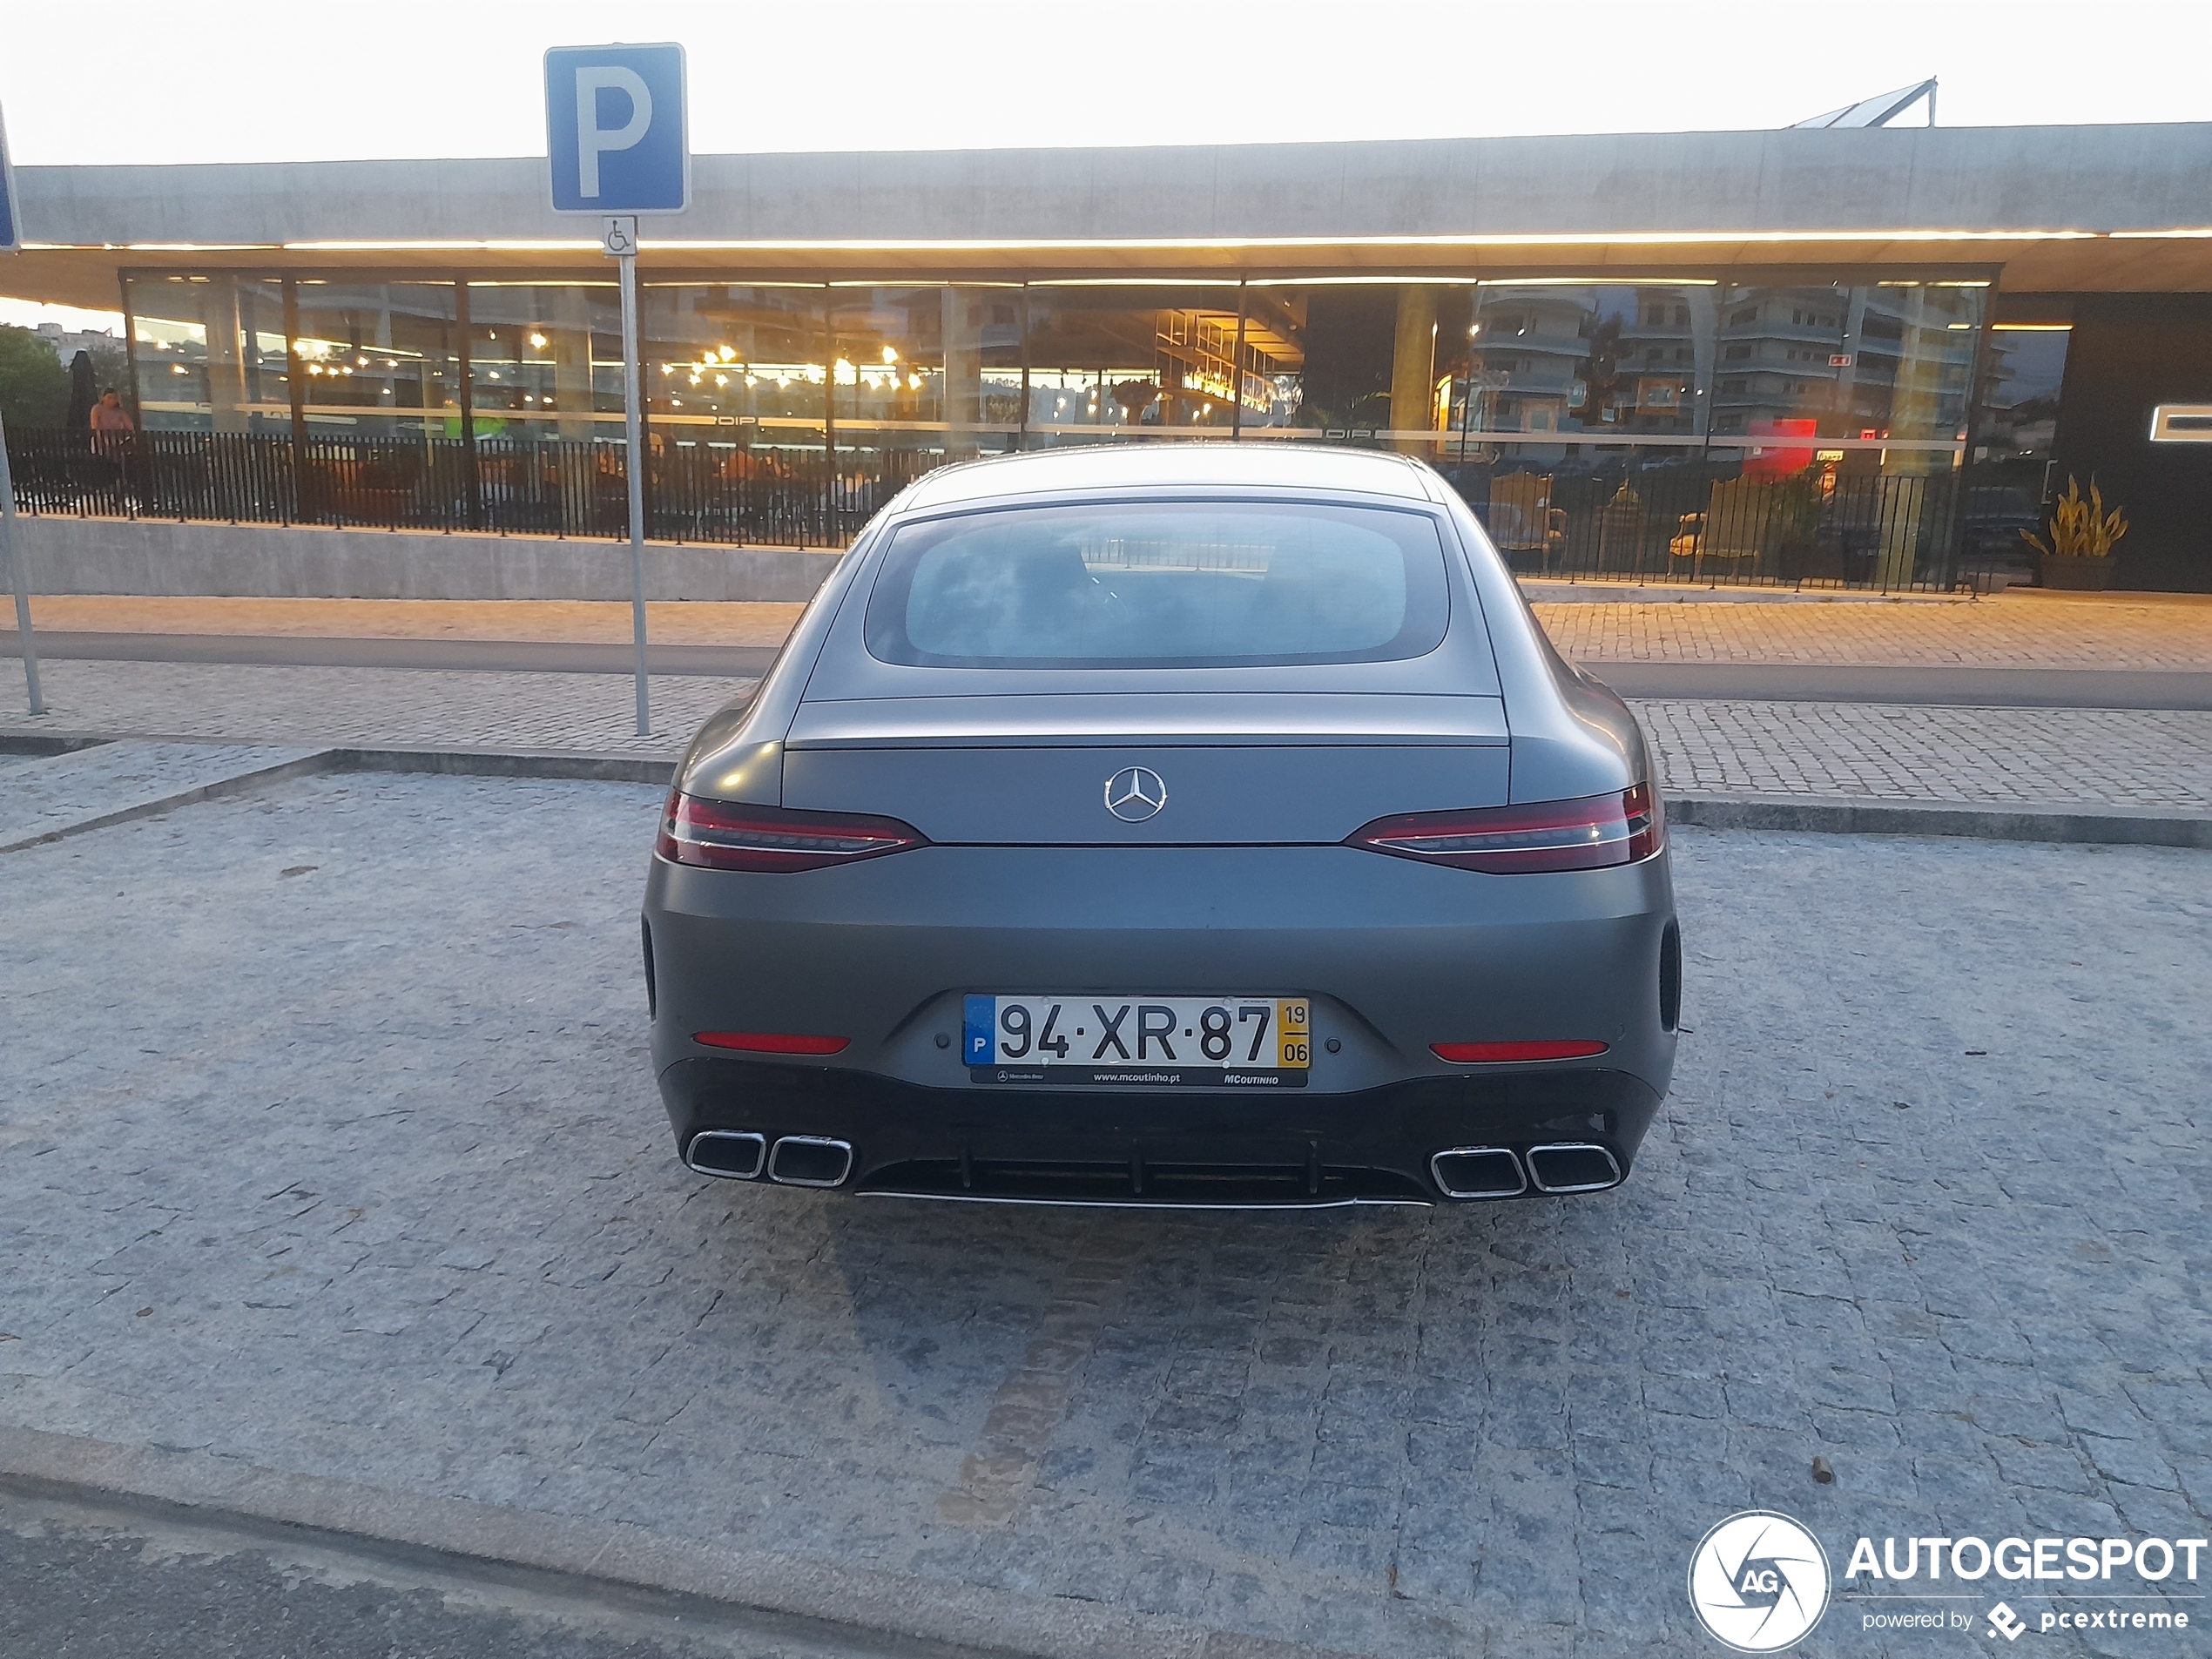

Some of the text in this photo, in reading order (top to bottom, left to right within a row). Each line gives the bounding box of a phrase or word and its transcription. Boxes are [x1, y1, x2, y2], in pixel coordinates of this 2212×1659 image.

[576, 66, 653, 198] P
[1285, 1006, 1305, 1024] 19
[974, 1037, 987, 1053] P
[1284, 1043, 1307, 1062] 06
[1093, 1073, 1181, 1084] www.mcoutinho.pt
